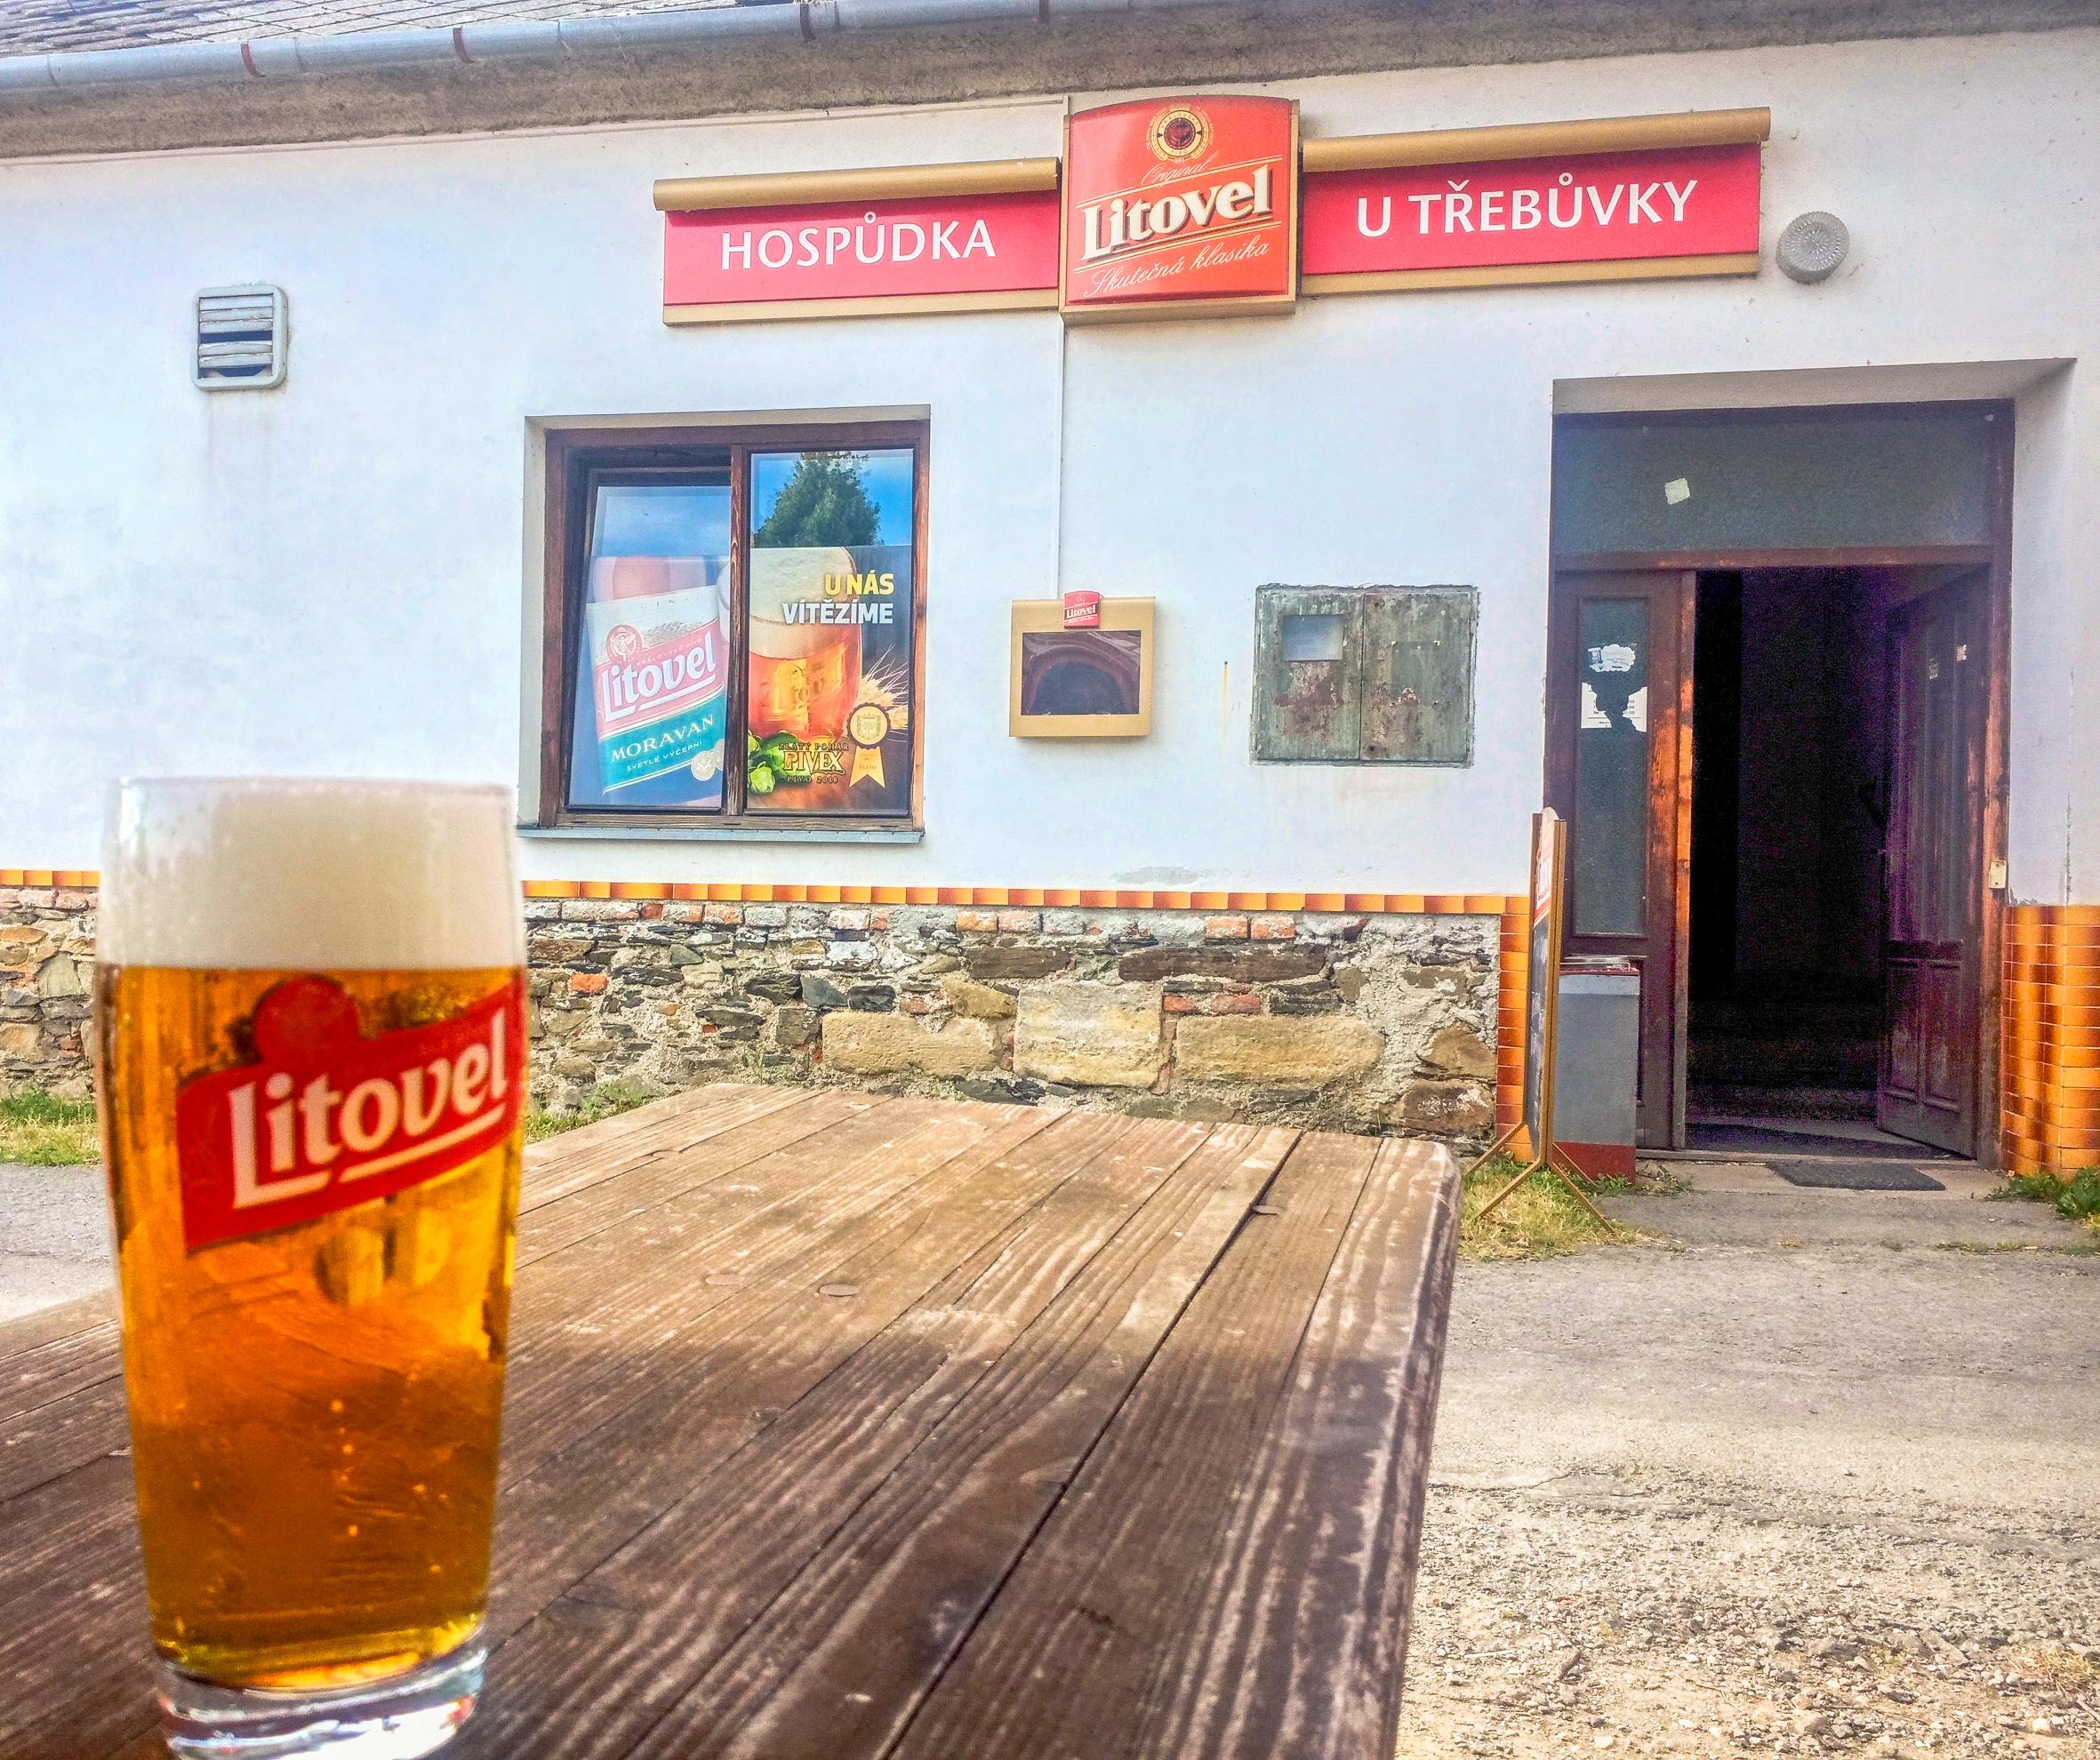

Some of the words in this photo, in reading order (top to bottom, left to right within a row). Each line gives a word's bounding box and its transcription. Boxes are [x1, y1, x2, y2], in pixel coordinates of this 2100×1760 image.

[1081, 164, 1273, 264] Litovel
[1357, 196, 1391, 237] U
[1408, 172, 1698, 235] TŘEBŮVKY
[721, 211, 996, 270] HOSPŮDKA
[1083, 256, 1184, 298] Skutečná
[1190, 235, 1269, 270] klasika
[825, 573, 841, 596] U
[846, 570, 895, 596] NÁS
[781, 597, 894, 625] VÍTĚZÍME
[1066, 604, 1096, 620] Litovel
[599, 629, 717, 724] Litovel
[612, 714, 715, 763] MORAVAN
[783, 750, 846, 775] PIVEX
[787, 775, 812, 783] PIVO
[228, 1007, 507, 1209] Litovel
